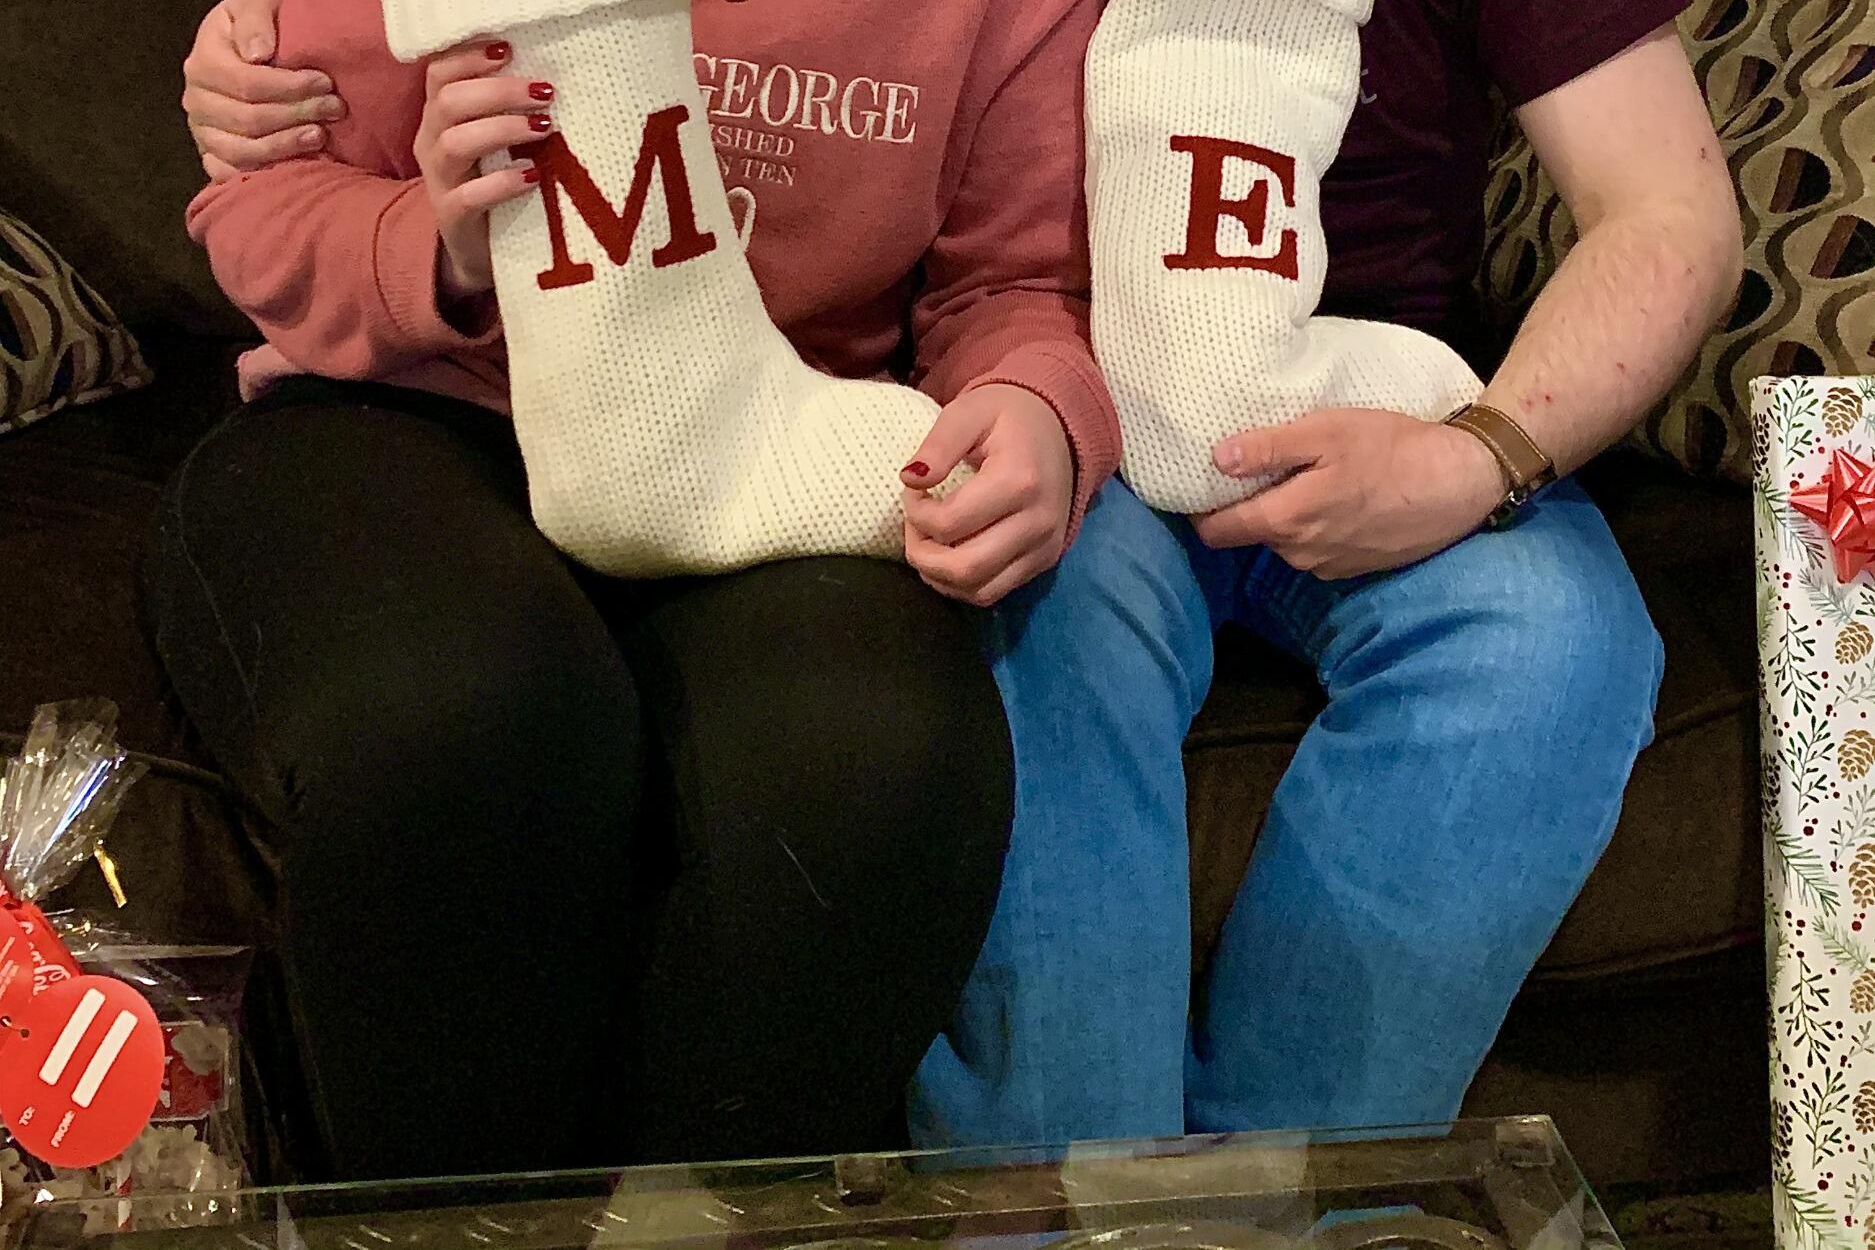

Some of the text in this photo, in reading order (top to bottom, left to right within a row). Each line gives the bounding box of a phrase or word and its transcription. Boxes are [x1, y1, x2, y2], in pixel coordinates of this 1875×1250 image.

[693, 52, 919, 144] GEORGE
[708, 123, 795, 157] SHED
[507, 104, 716, 290] M
[1161, 134, 1299, 282] E
